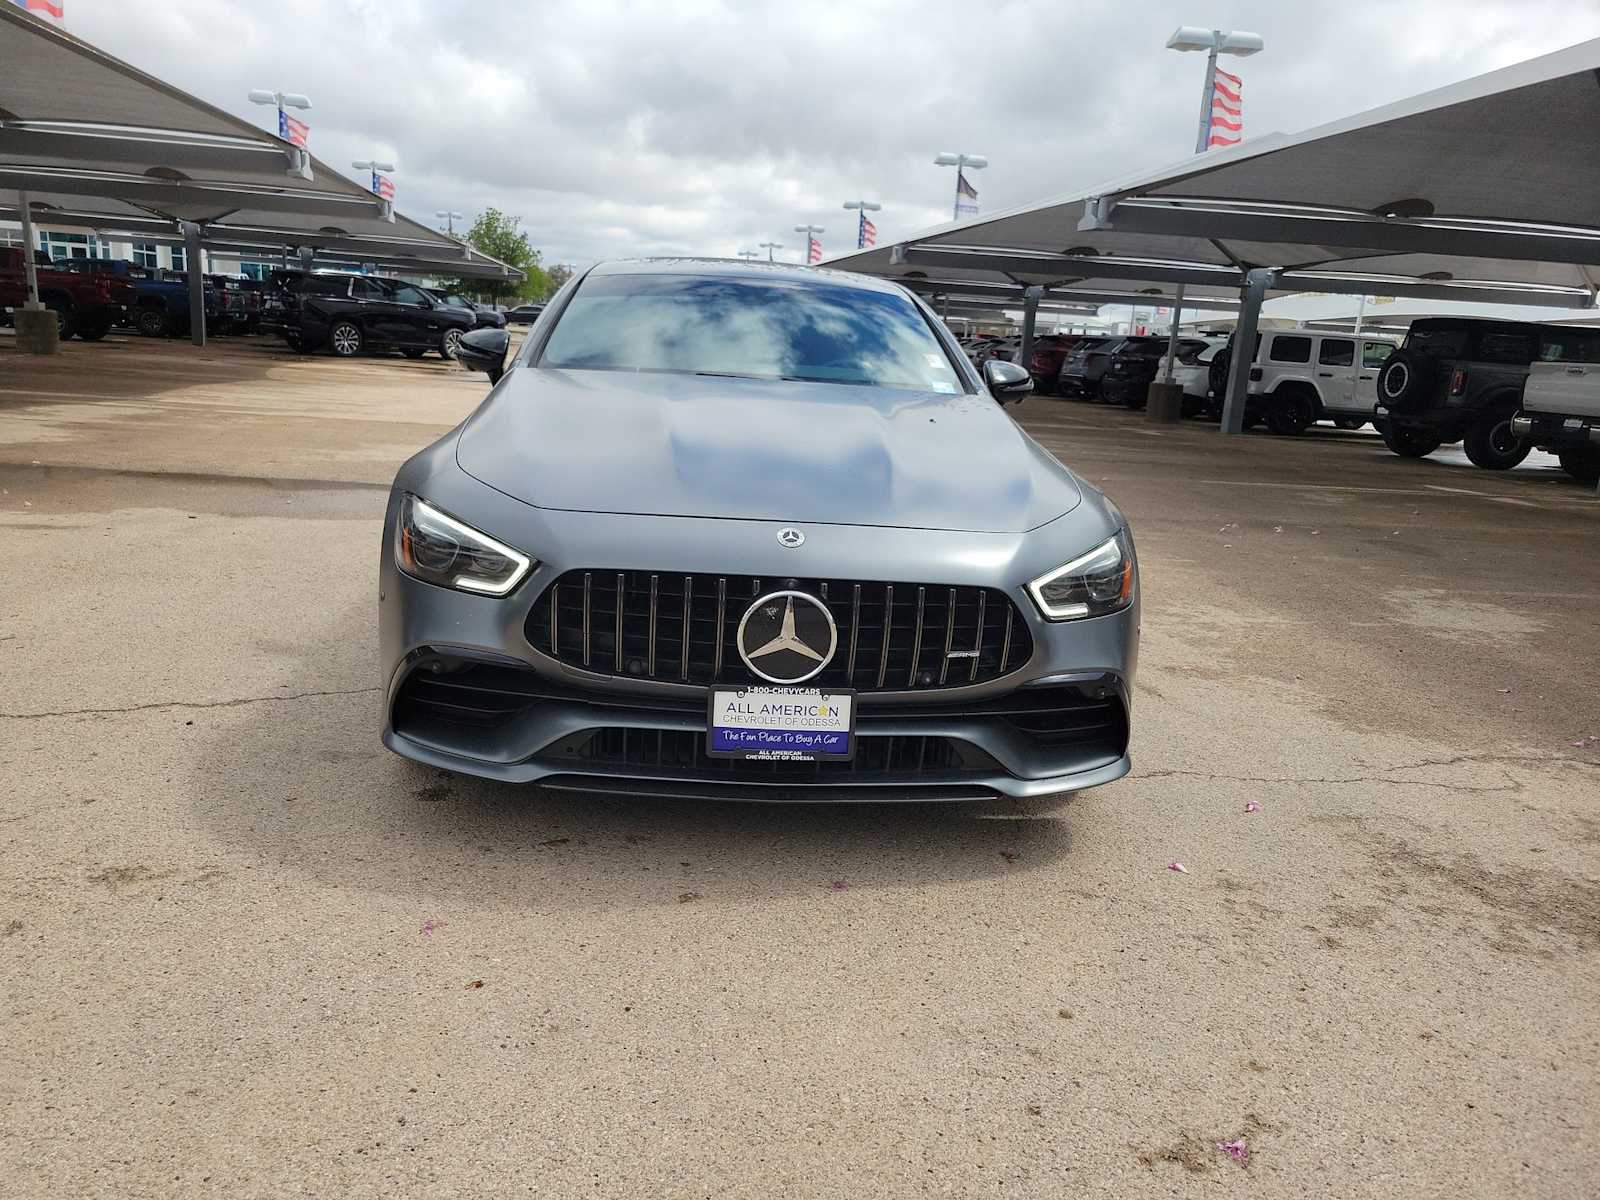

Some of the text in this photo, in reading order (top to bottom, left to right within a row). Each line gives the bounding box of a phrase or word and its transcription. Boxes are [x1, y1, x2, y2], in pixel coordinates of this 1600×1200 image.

[747, 686, 820, 696] 1-800-CHEVYCARS
[726, 702, 839, 717] ALL AMERICN
[723, 714, 841, 727] CHEVROLET OF ODESSA
[722, 730, 739, 741] The
[758, 731, 782, 742] Place
[783, 733, 794, 743] To
[795, 734, 813, 746] Buy
[813, 734, 822, 744] A
[823, 734, 839, 744] Car
